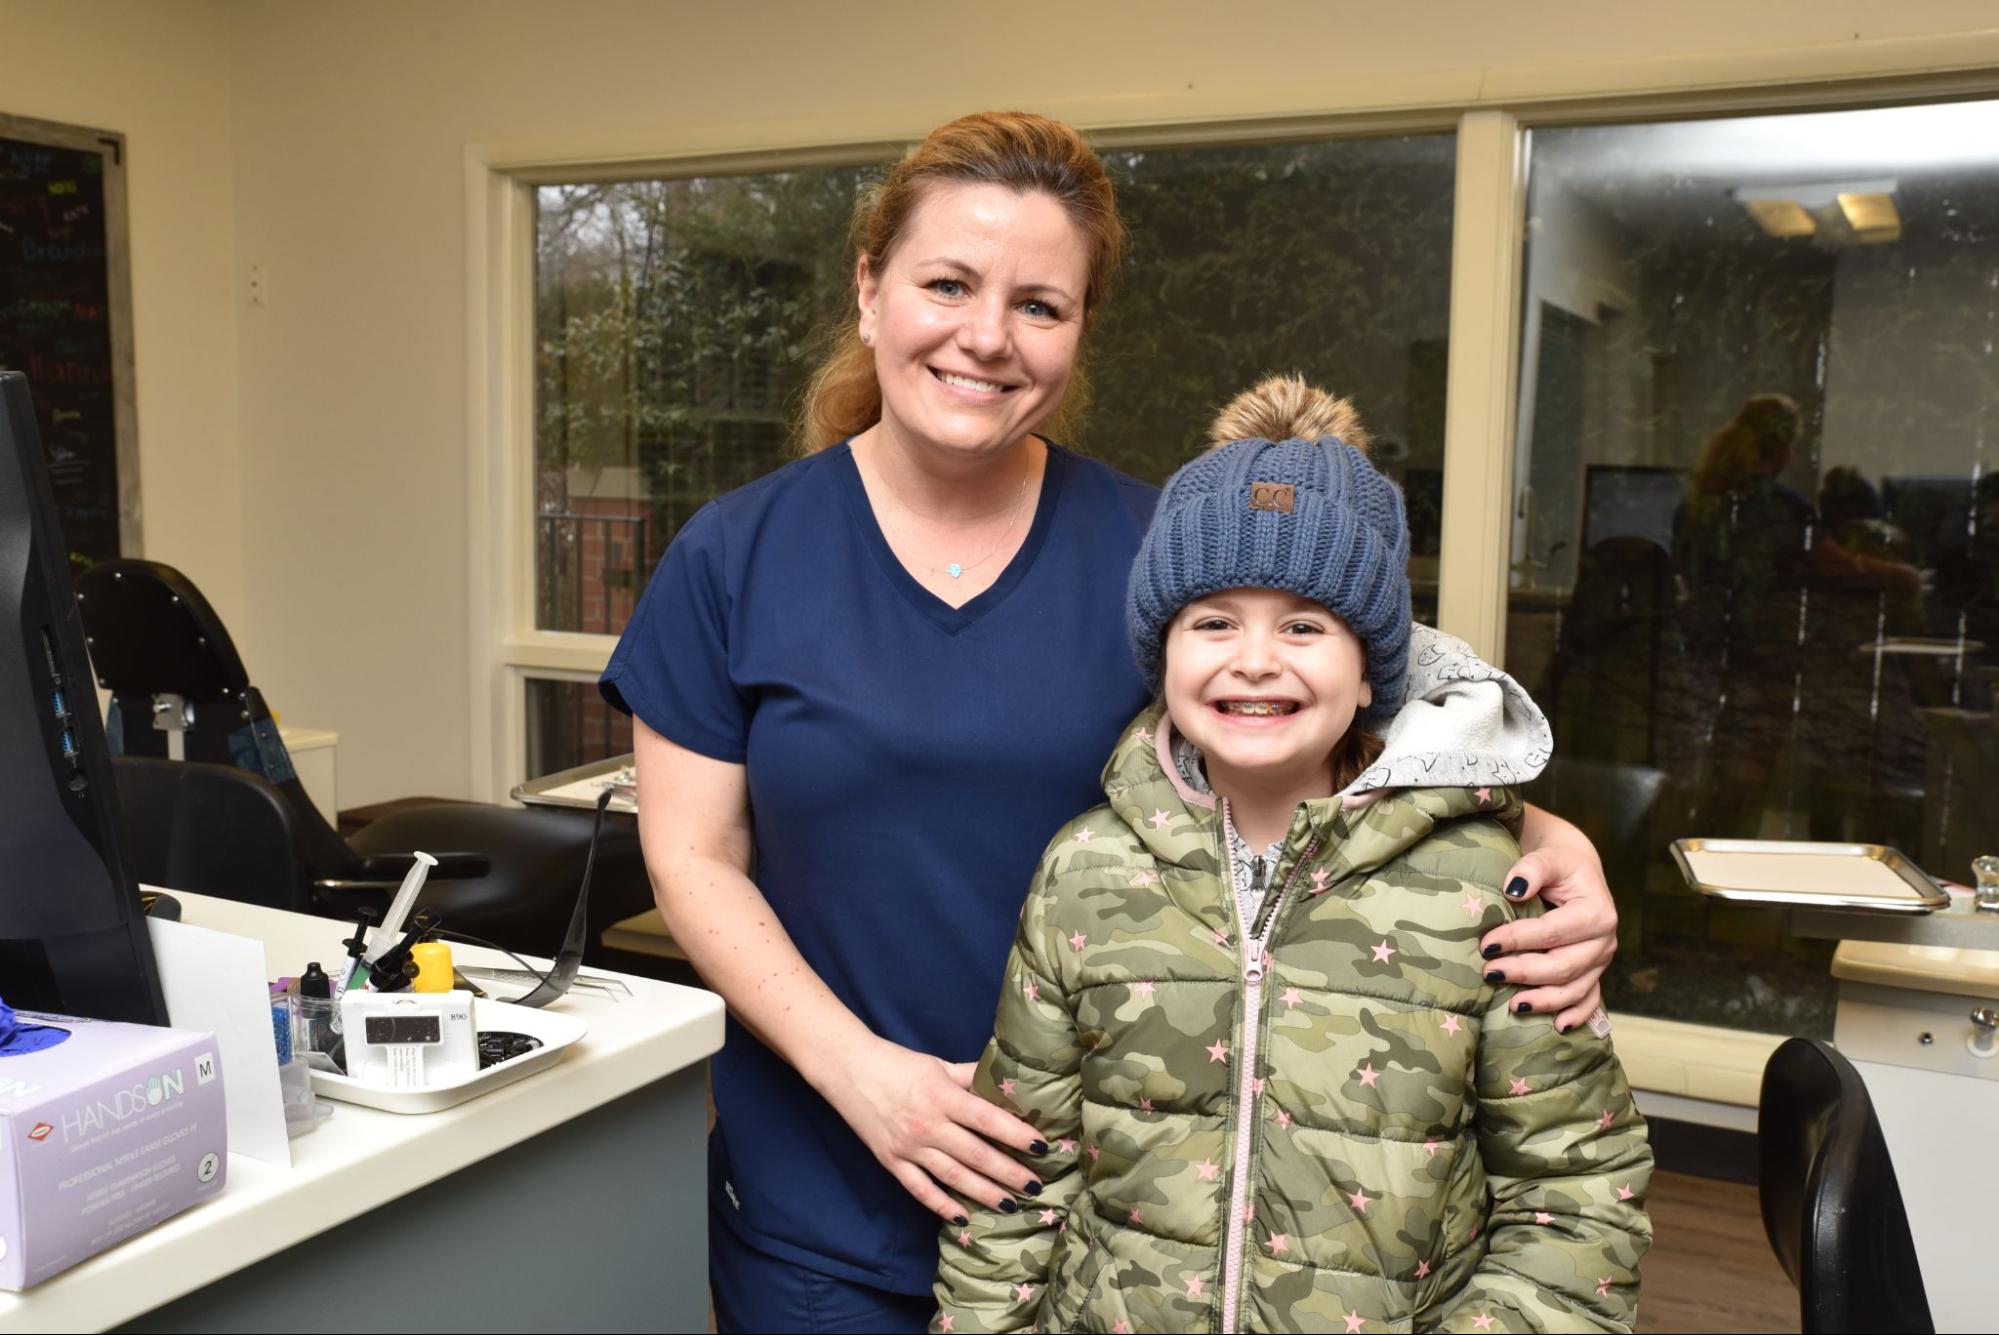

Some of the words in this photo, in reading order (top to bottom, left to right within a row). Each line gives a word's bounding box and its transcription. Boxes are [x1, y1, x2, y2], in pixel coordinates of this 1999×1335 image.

[450, 1013, 467, 1021] 890
[199, 1061, 212, 1078] M
[203, 1160, 213, 1176] 2
